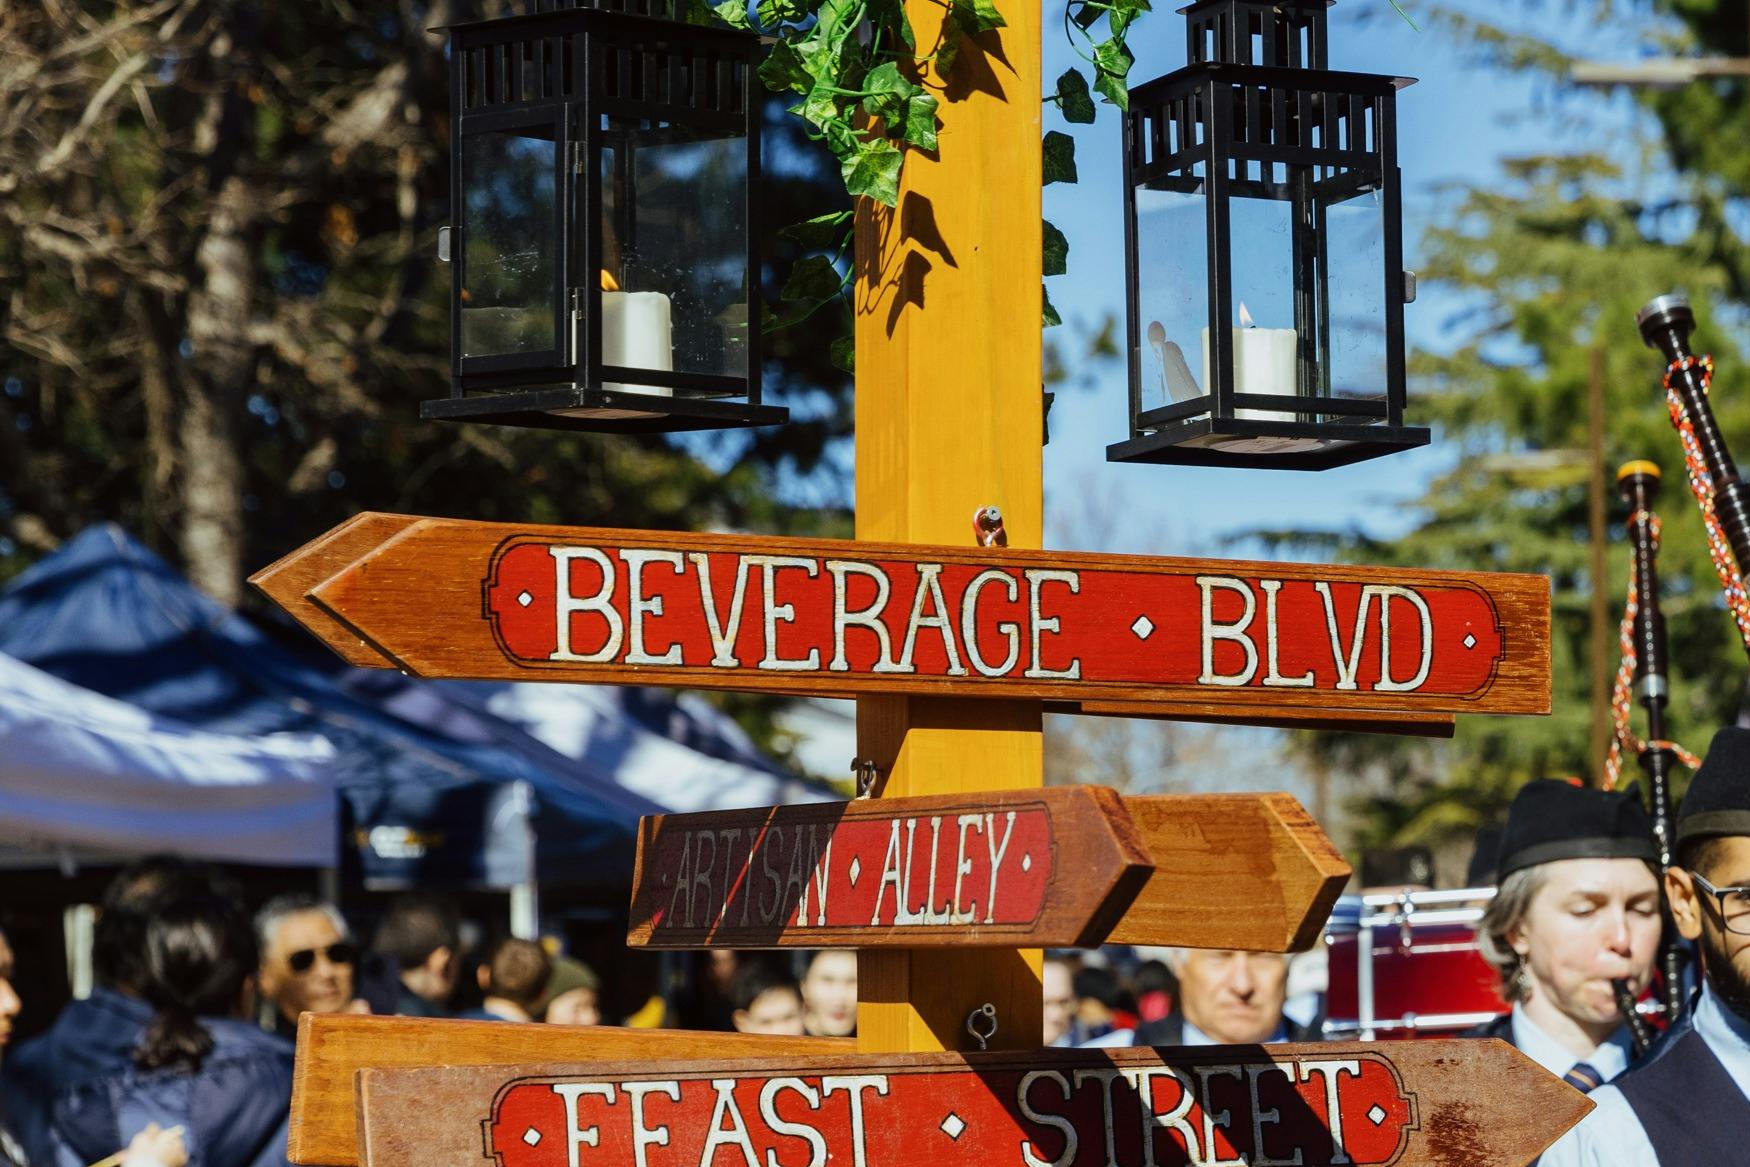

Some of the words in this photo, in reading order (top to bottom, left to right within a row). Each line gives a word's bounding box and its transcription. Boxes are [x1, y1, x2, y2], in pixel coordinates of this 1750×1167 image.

[547, 543, 1081, 680] BEVERAGE
[1195, 574, 1434, 692] BLVD
[664, 821, 834, 928] ARTISAN
[869, 810, 1016, 926] ALLEY
